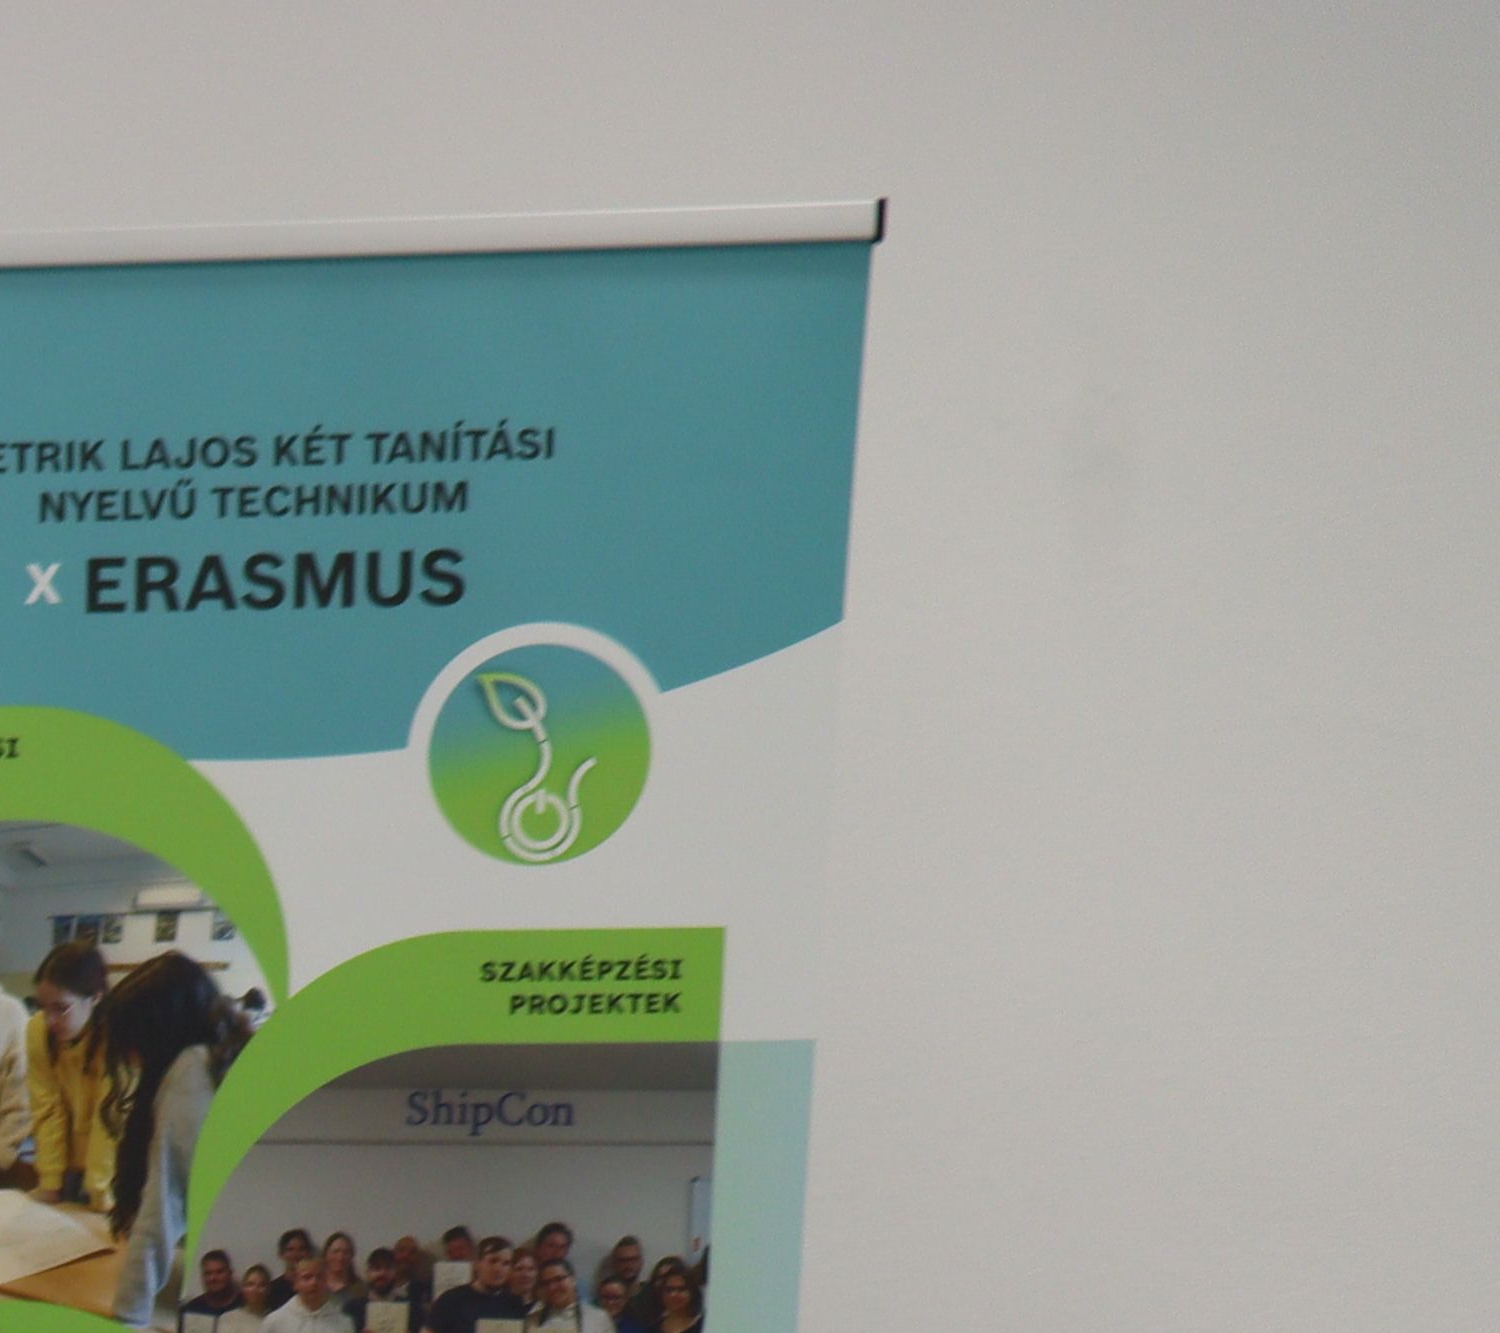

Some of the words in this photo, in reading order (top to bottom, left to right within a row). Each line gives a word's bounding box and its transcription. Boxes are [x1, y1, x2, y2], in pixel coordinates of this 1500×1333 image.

[120, 432, 257, 474] LAJOS
[271, 423, 351, 470] KÉT
[367, 420, 556, 468] TANÍTÁSI
[37, 482, 198, 526] NYELVŰ
[210, 478, 470, 521] TECHNIKUM
[84, 550, 467, 614] ERASMUS
[479, 954, 684, 983] SZAKKÉPZÉSI
[509, 991, 682, 1016] PROJEKTEK
[406, 1089, 576, 1136] ShipCon
